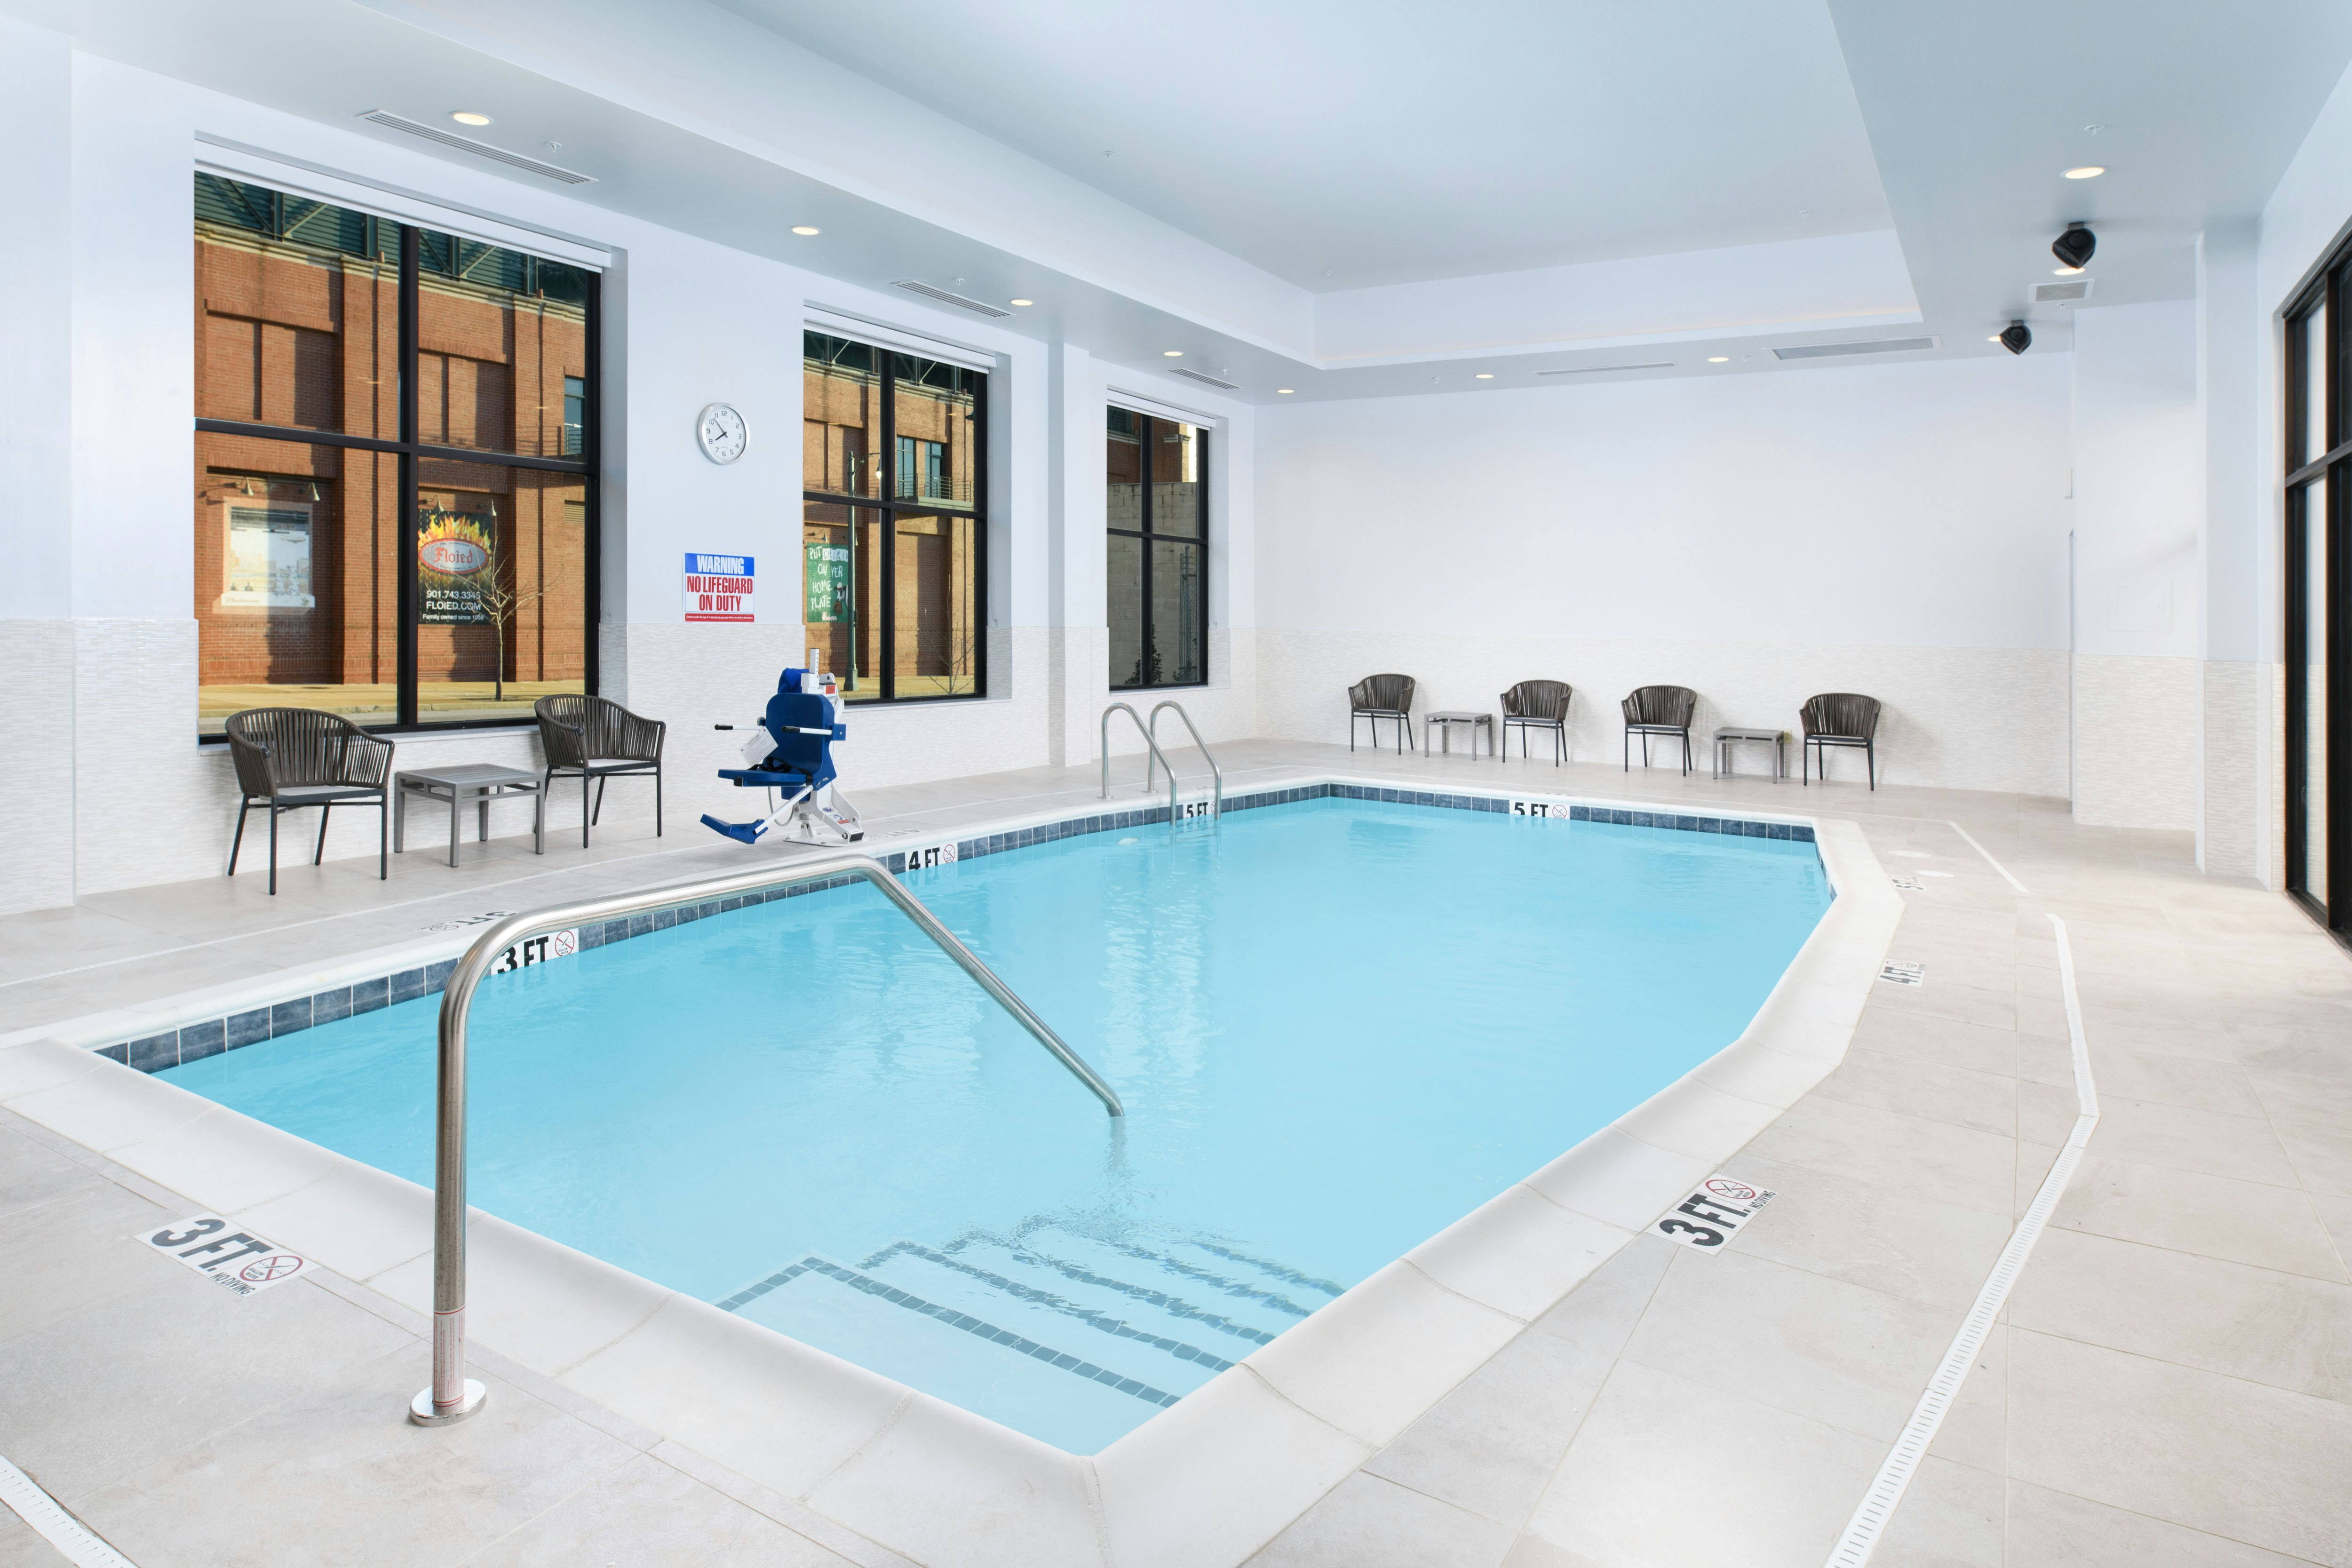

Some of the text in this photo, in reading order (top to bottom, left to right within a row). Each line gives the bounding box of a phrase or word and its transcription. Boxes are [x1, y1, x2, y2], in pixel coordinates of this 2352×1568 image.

[433, 547, 473, 564] Floied
[810, 546, 822, 559] PUT
[697, 555, 744, 574] WARNING
[818, 564, 843, 579] ON YER
[687, 575, 753, 594] NO LIFEGUARD
[812, 580, 832, 594] HOME
[427, 590, 480, 599] 901.743.3345
[426, 601, 481, 610] FLOIED.COM
[699, 594, 741, 611] ON DUTY
[811, 595, 831, 610] PLATE
[1186, 802, 1208, 818] 5 FT
[1514, 802, 1548, 817] 5 FT
[909, 847, 940, 870] 4 FT
[497, 936, 549, 973] 3 FT
[1880, 975, 1918, 984] 4
[1754, 1190, 1776, 1204] DIVING
[1659, 1193, 1751, 1246] 3 FT.
[151, 1218, 274, 1272] 3 FT.
[247, 1267, 264, 1275] SHALLOW
[209, 1272, 256, 1294] NO DIVING
